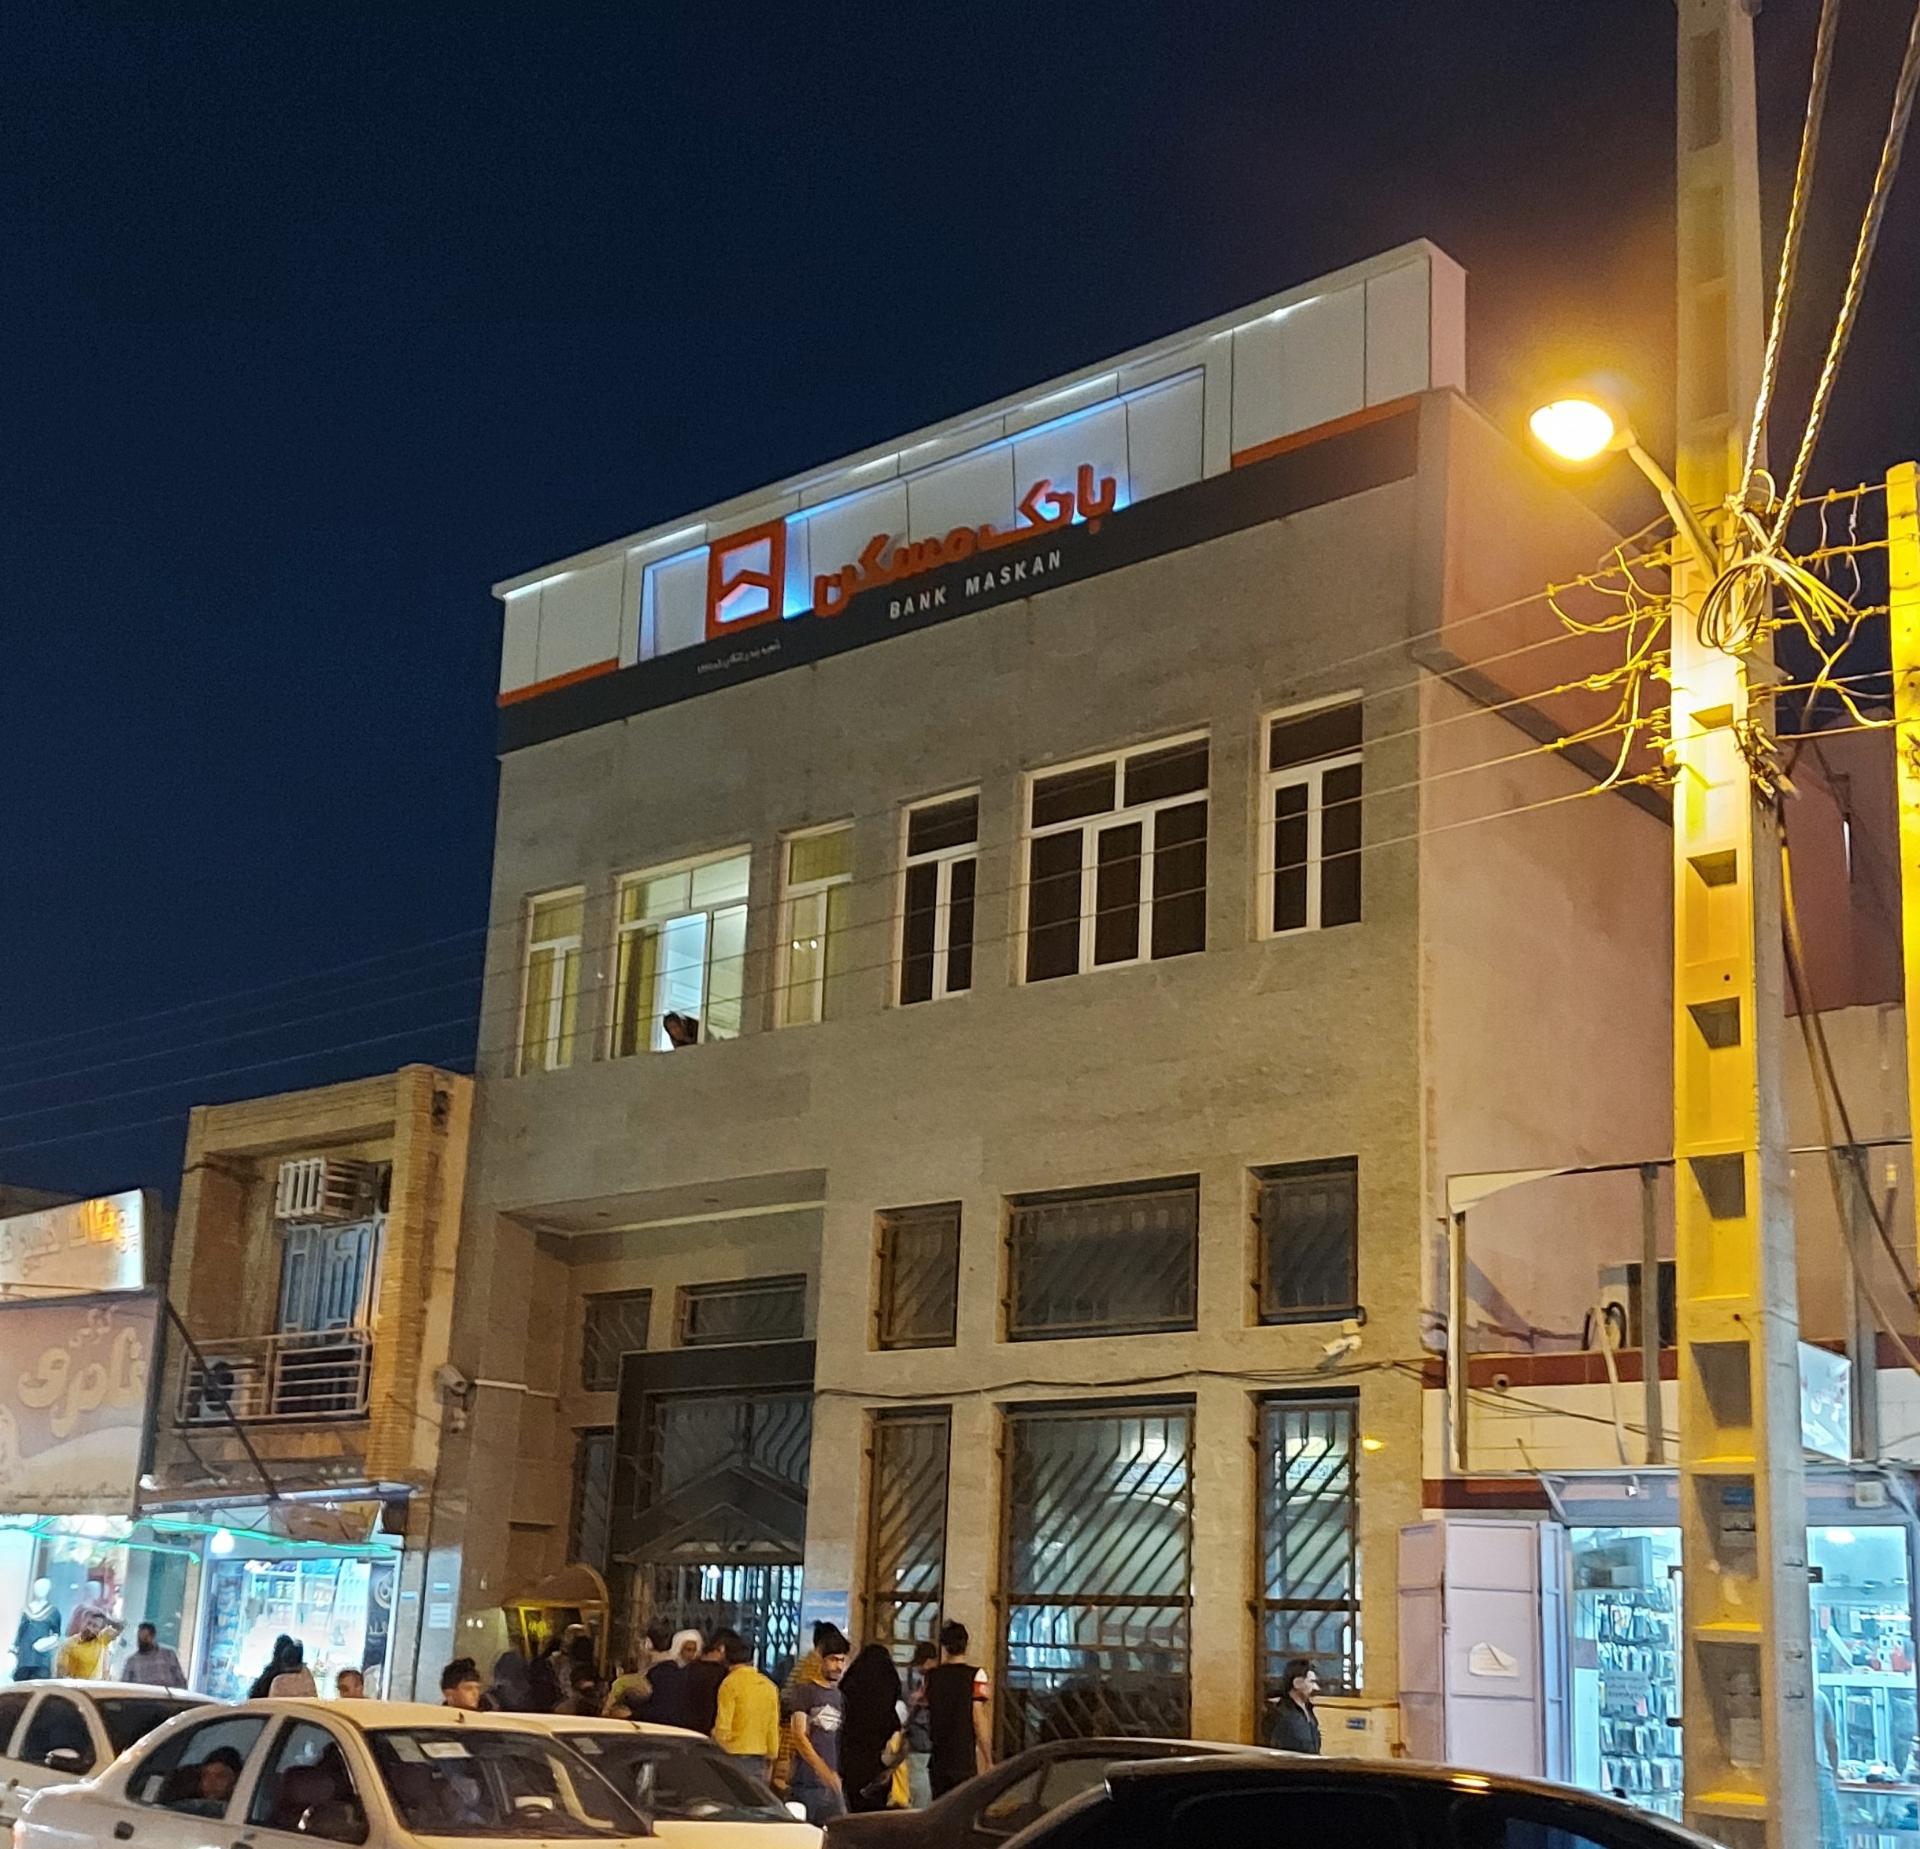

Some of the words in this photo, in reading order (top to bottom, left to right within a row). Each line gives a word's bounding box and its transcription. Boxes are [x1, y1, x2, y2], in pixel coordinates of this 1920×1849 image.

[977, 463, 1117, 535] بانک
[812, 525, 979, 618] مسکن
[889, 586, 948, 620] BANK
[965, 550, 1061, 597] MASKAN
